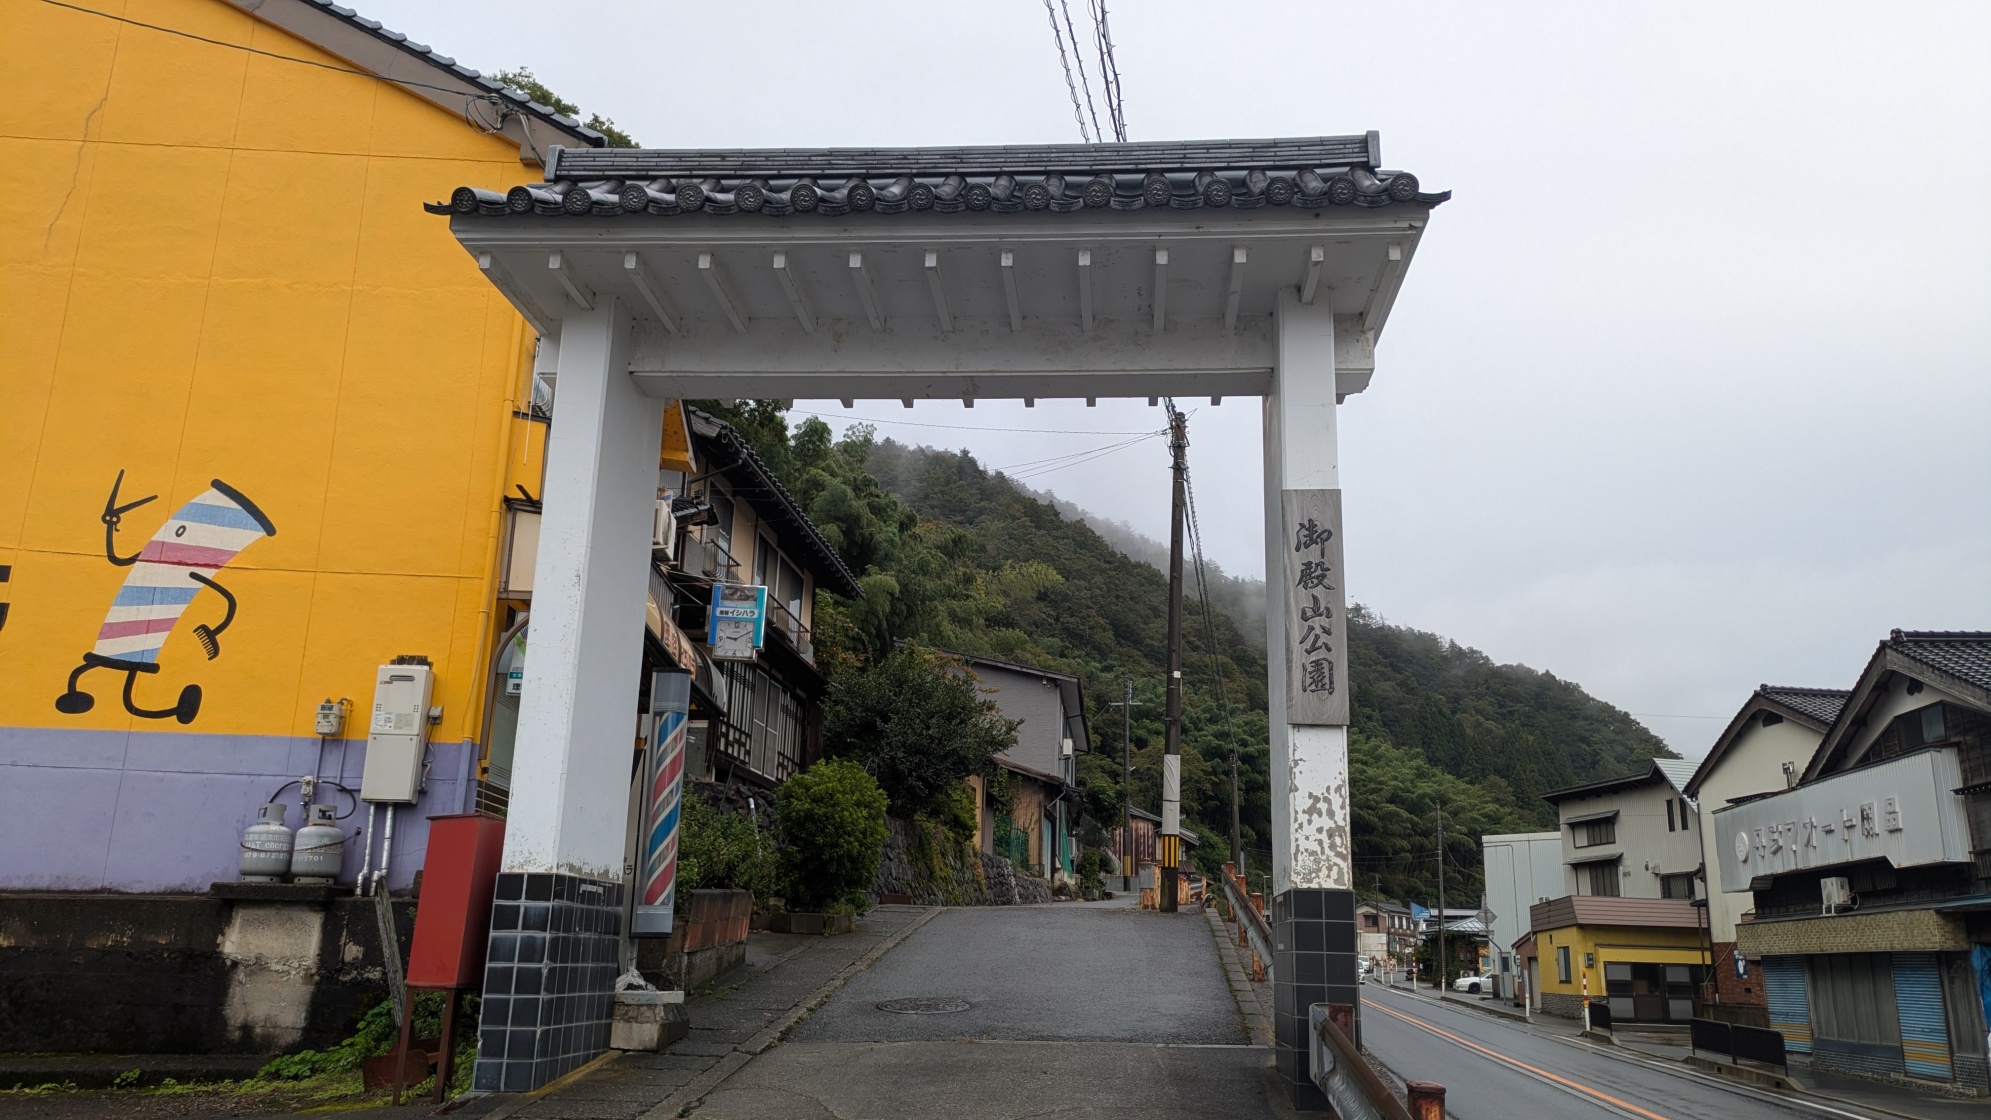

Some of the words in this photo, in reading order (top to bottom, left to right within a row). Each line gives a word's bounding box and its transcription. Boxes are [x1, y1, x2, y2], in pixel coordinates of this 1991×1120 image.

[1295, 518, 1335, 695] 御殿山公園
